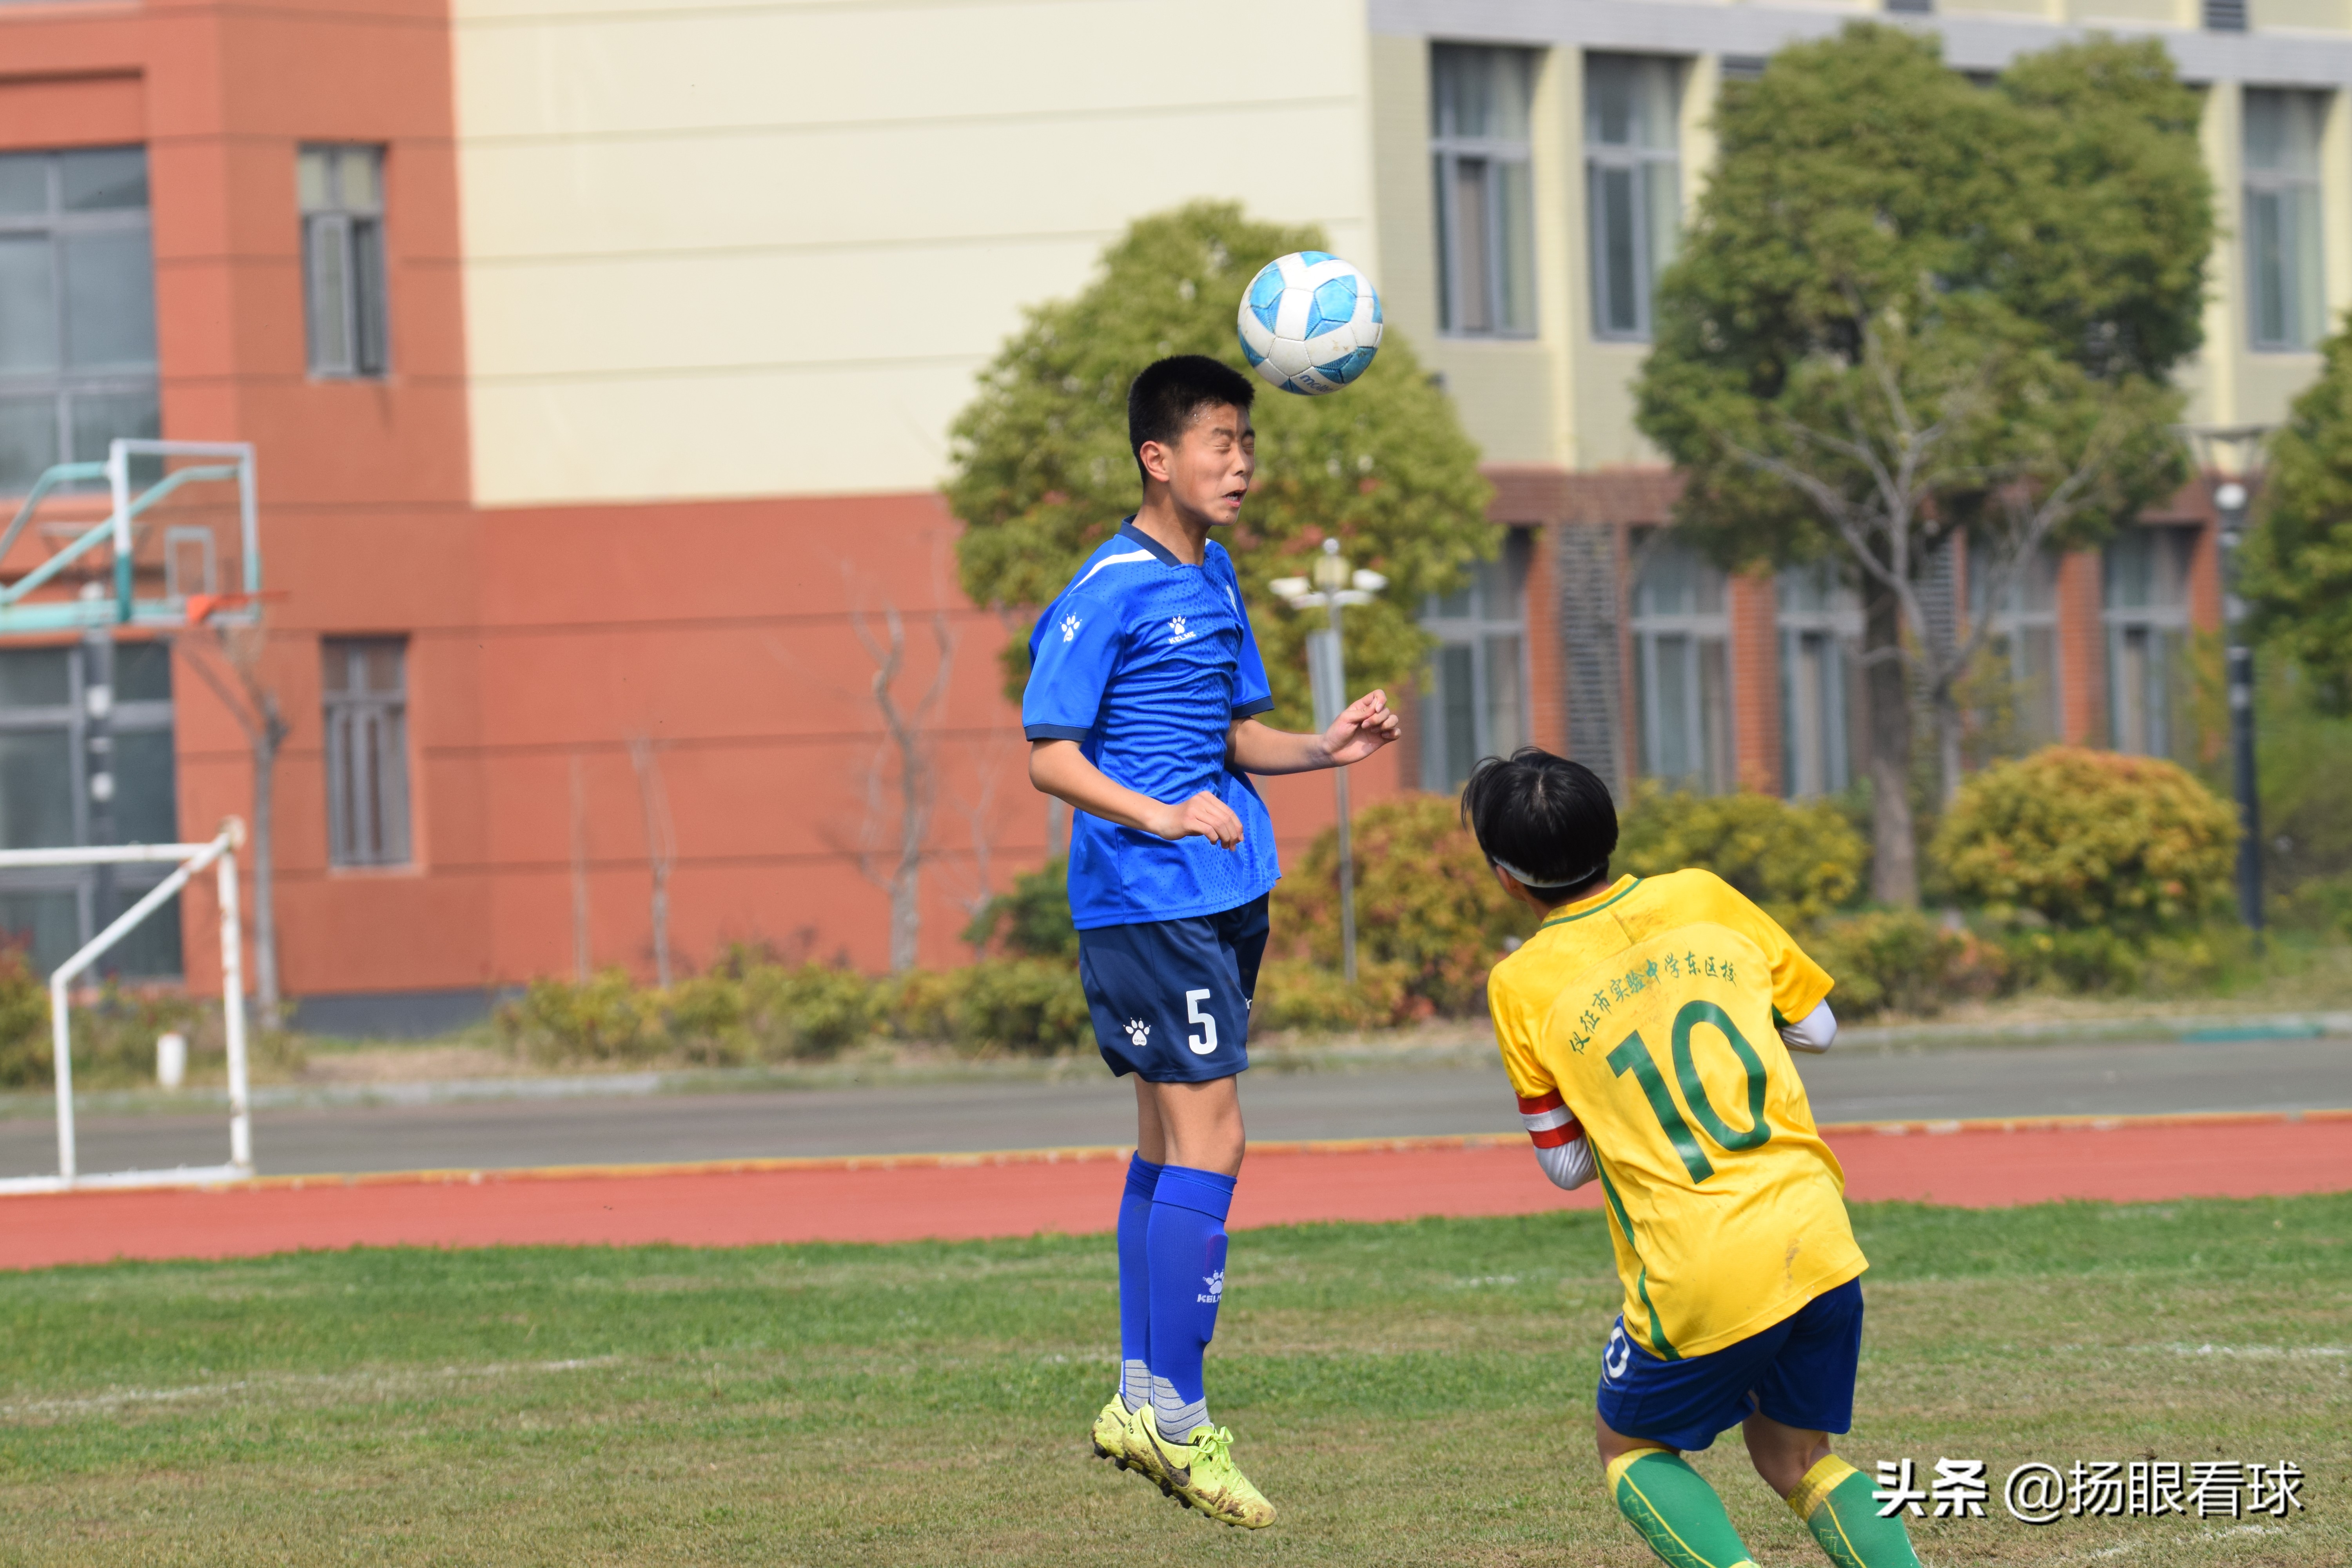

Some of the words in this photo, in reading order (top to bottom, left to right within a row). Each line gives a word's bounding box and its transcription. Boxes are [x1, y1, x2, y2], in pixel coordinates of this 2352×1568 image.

[1169, 631, 1196, 644] KELME
[1186, 989, 1217, 1054] 5
[1569, 951, 1737, 1055] 仪征市实验中学东区校
[1606, 1000, 1771, 1185] 10
